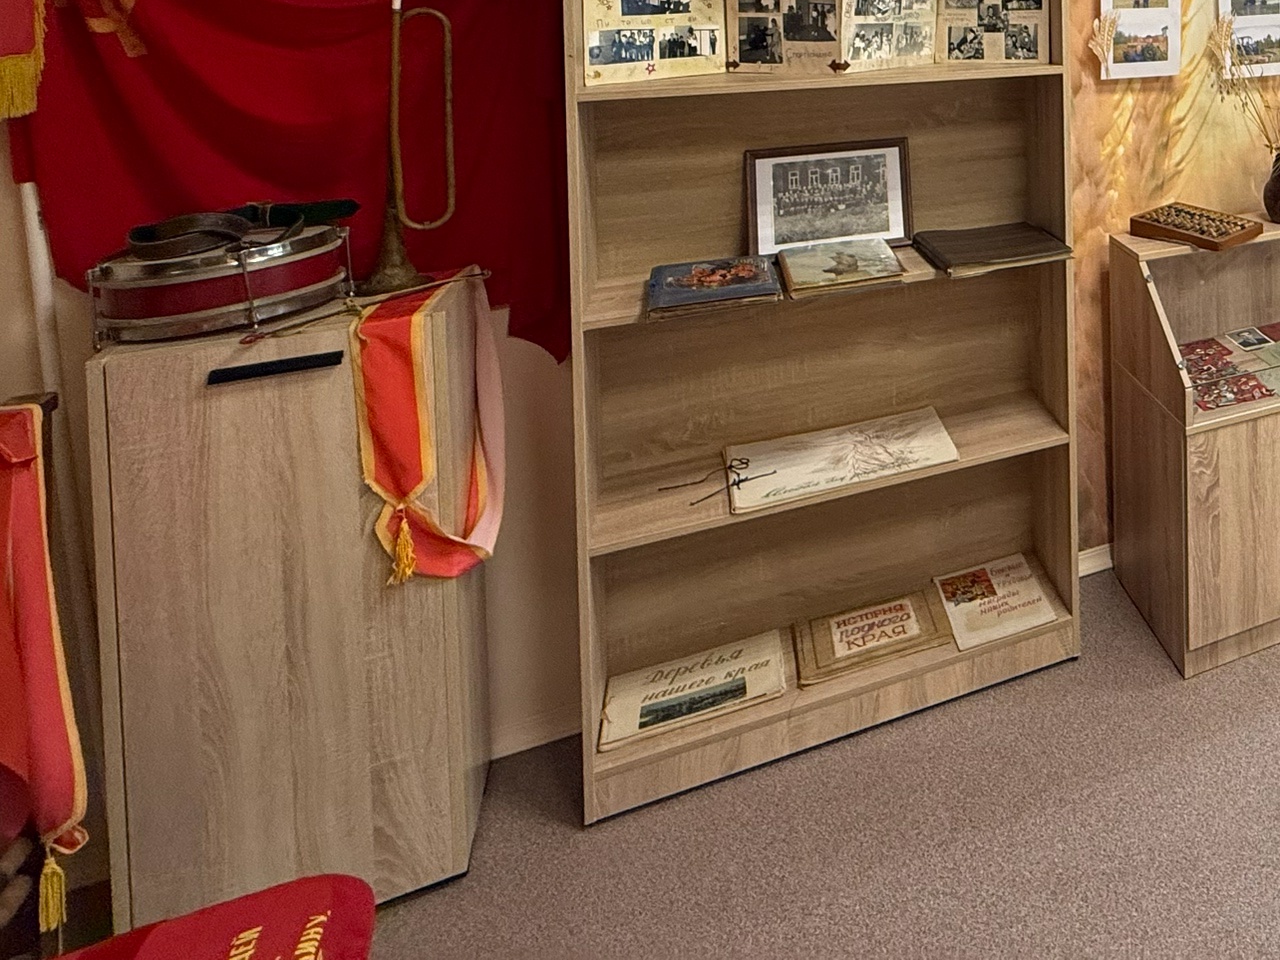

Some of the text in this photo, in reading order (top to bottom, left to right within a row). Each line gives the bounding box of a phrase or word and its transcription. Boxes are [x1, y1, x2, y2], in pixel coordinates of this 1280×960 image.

[835, 603, 906, 630] ИСТОРИЯ
[980, 601, 1010, 616] наших
[996, 595, 1043, 618] родителей
[846, 624, 908, 651] КРАЯ
[641, 659, 772, 704] нашего края
